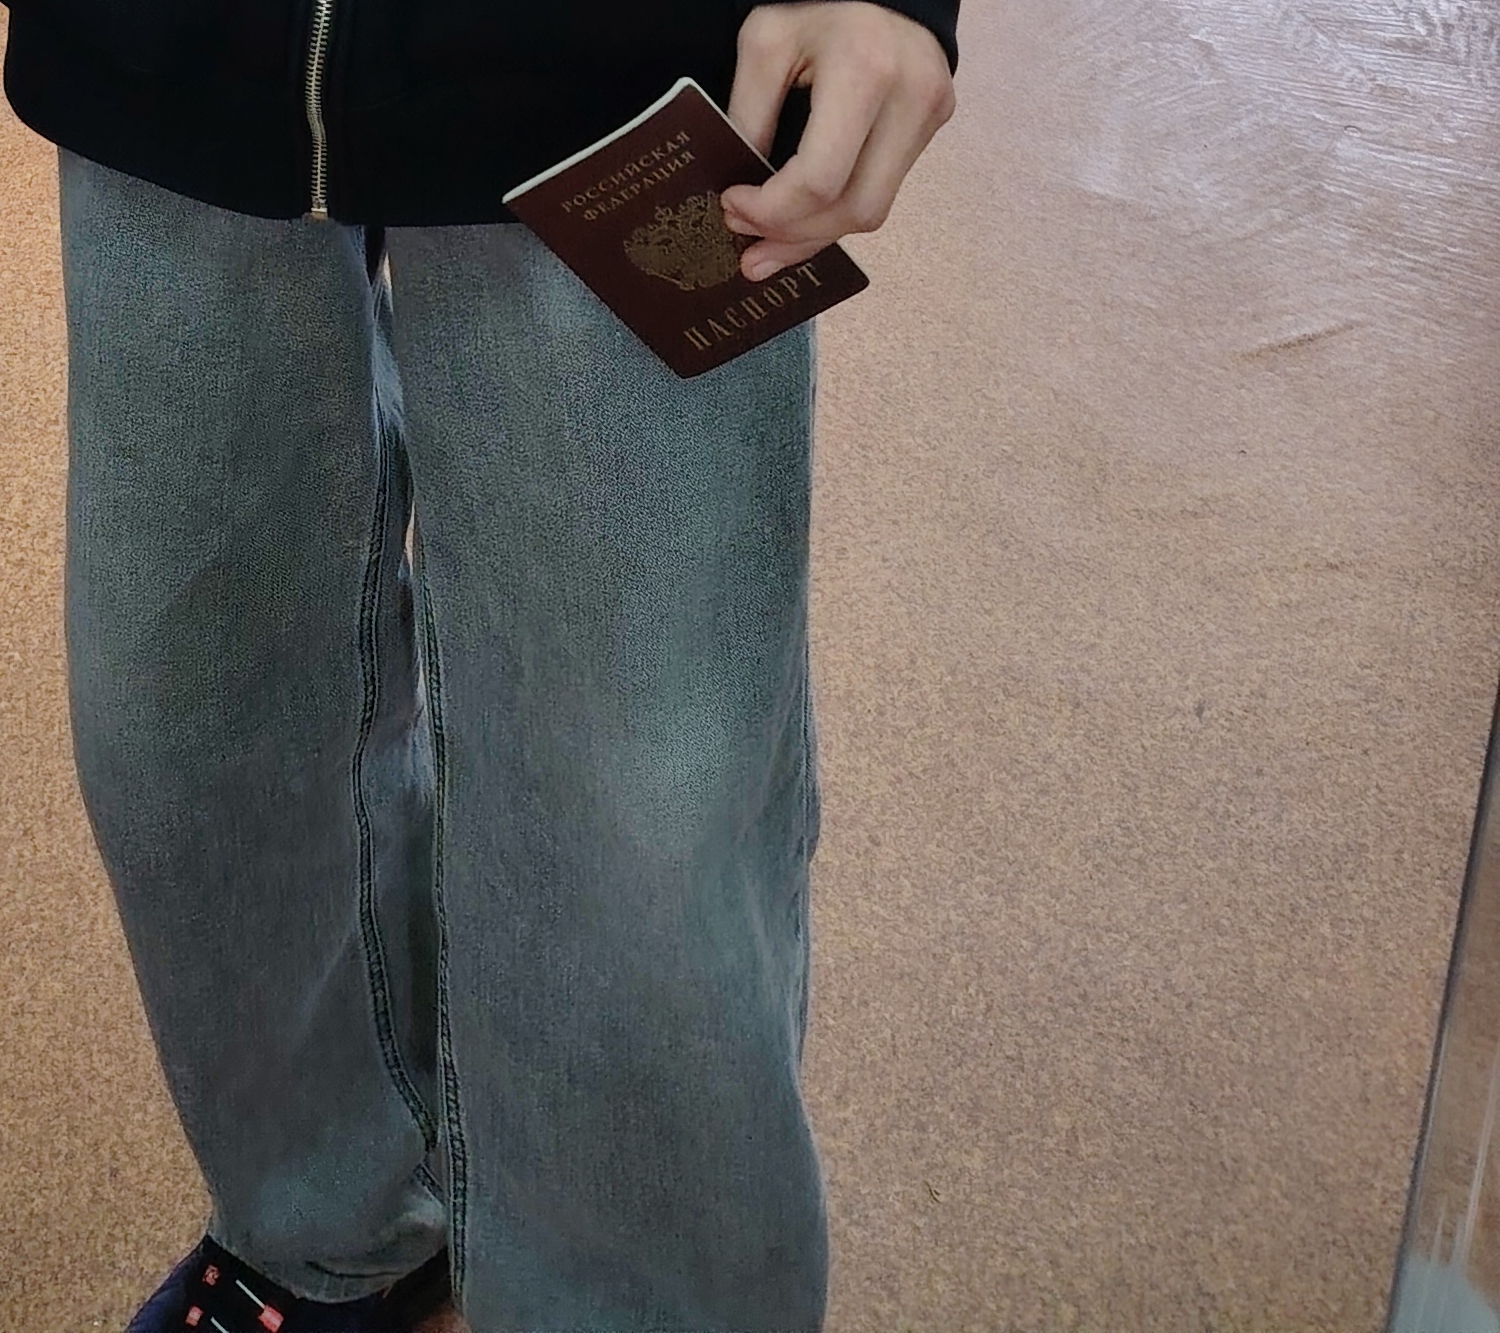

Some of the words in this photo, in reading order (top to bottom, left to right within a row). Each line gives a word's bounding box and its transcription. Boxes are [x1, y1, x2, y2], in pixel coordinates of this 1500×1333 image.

[560, 131, 691, 213] РОССИЙСКАЯ
[583, 151, 696, 221] ФЕДЕРАЦИЯ
[683, 262, 822, 351] ПАСПОРТ
